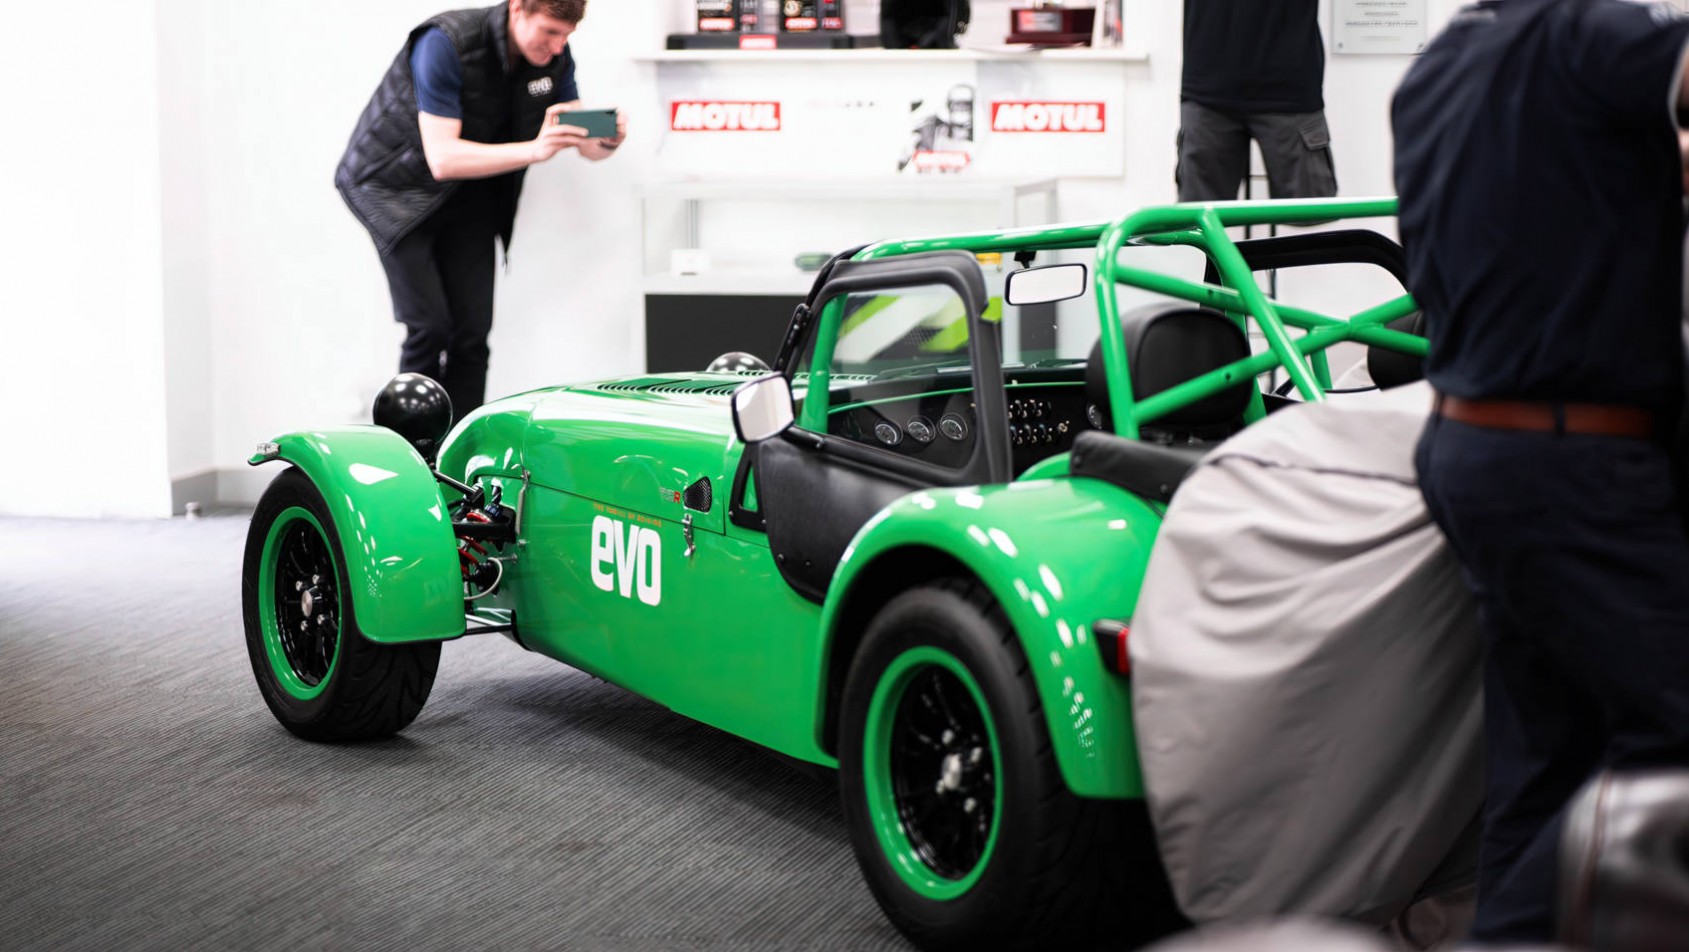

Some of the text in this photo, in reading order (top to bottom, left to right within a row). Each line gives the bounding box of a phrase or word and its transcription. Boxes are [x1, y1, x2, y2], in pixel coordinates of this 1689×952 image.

[672, 102, 779, 130] MOTUL
[993, 103, 1103, 131] MOTUL
[590, 514, 662, 607] evo
